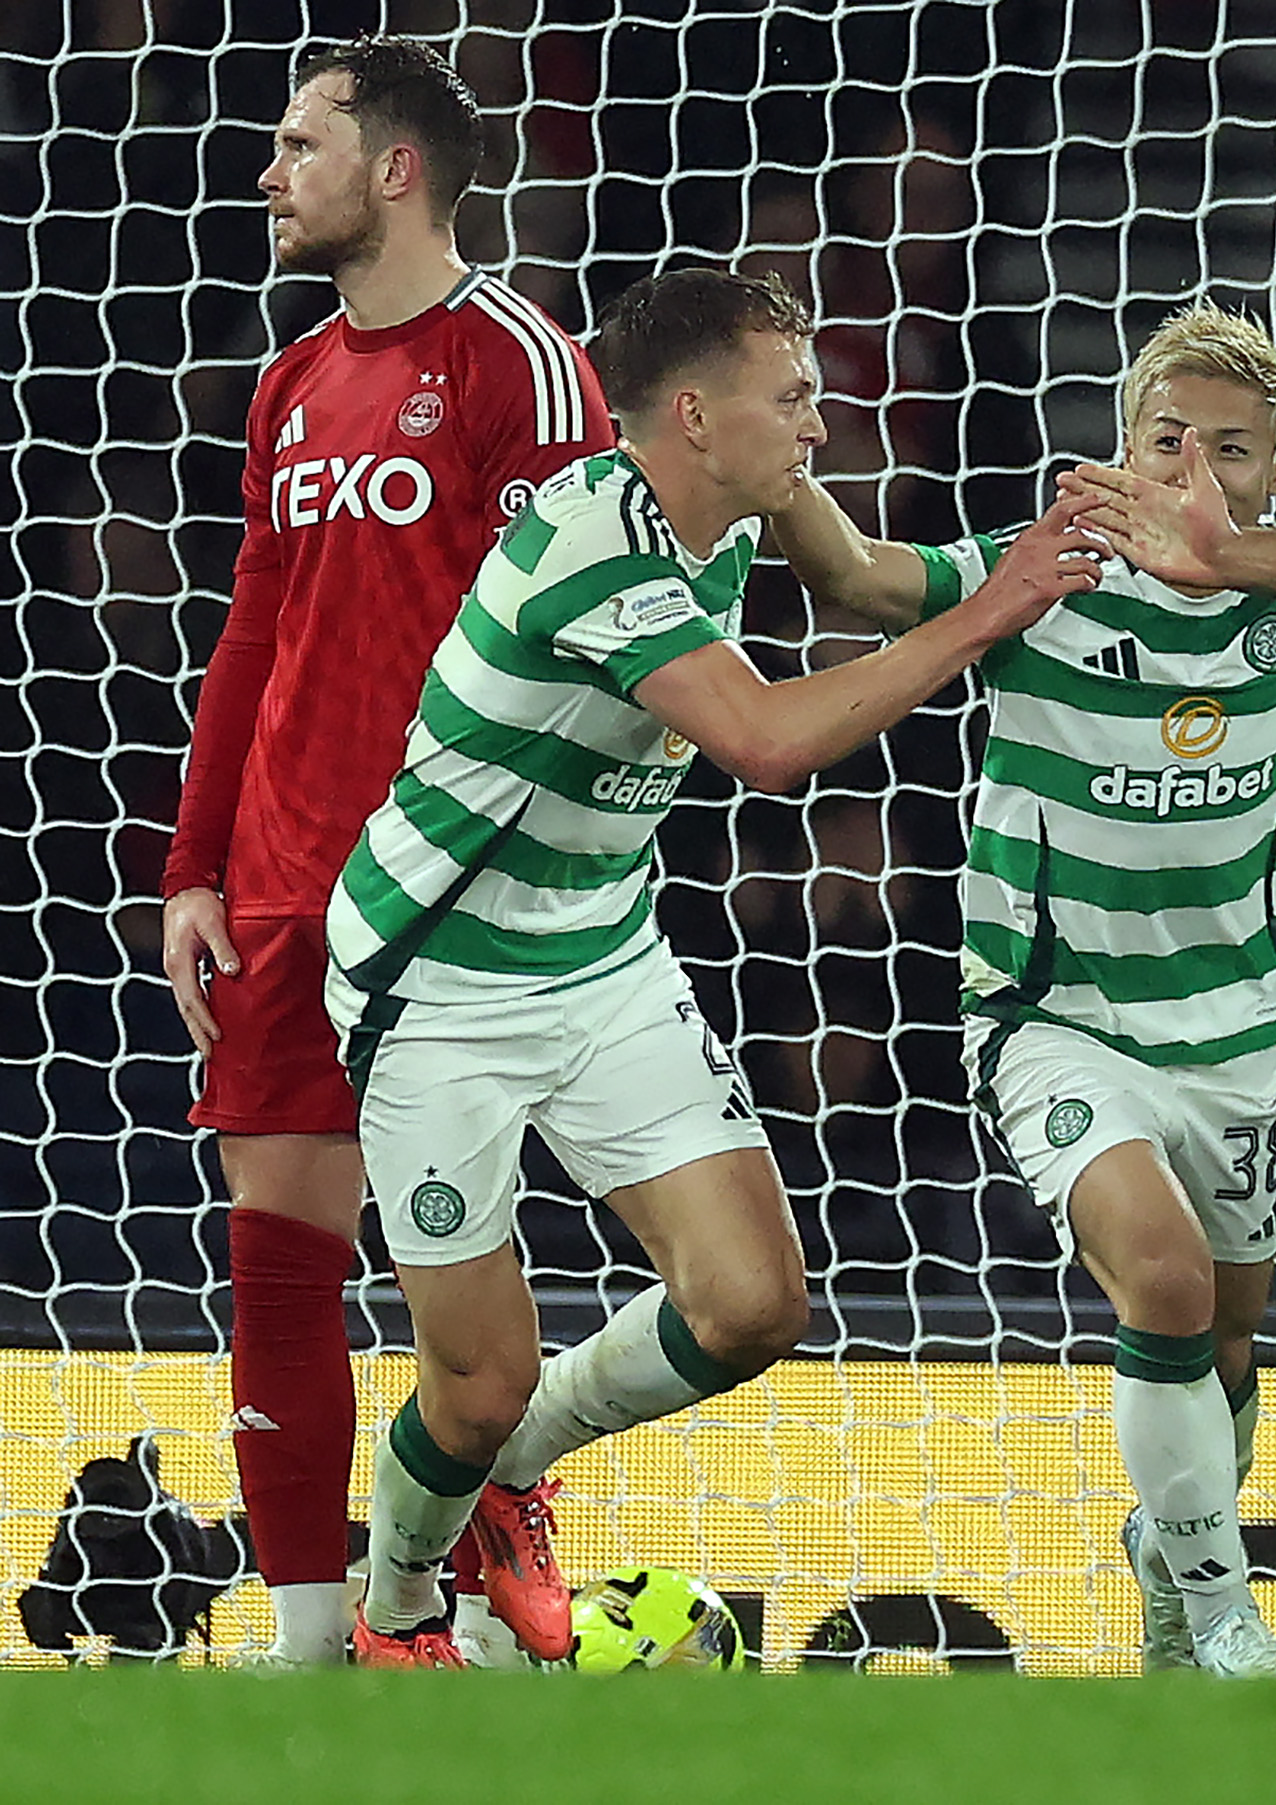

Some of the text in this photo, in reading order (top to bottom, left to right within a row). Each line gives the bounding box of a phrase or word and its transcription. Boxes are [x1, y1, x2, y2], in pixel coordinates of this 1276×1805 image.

[271, 454, 433, 534] TEXO
[1090, 757, 1275, 818] dafabet
[1154, 1510, 1226, 1537] CELTIC
